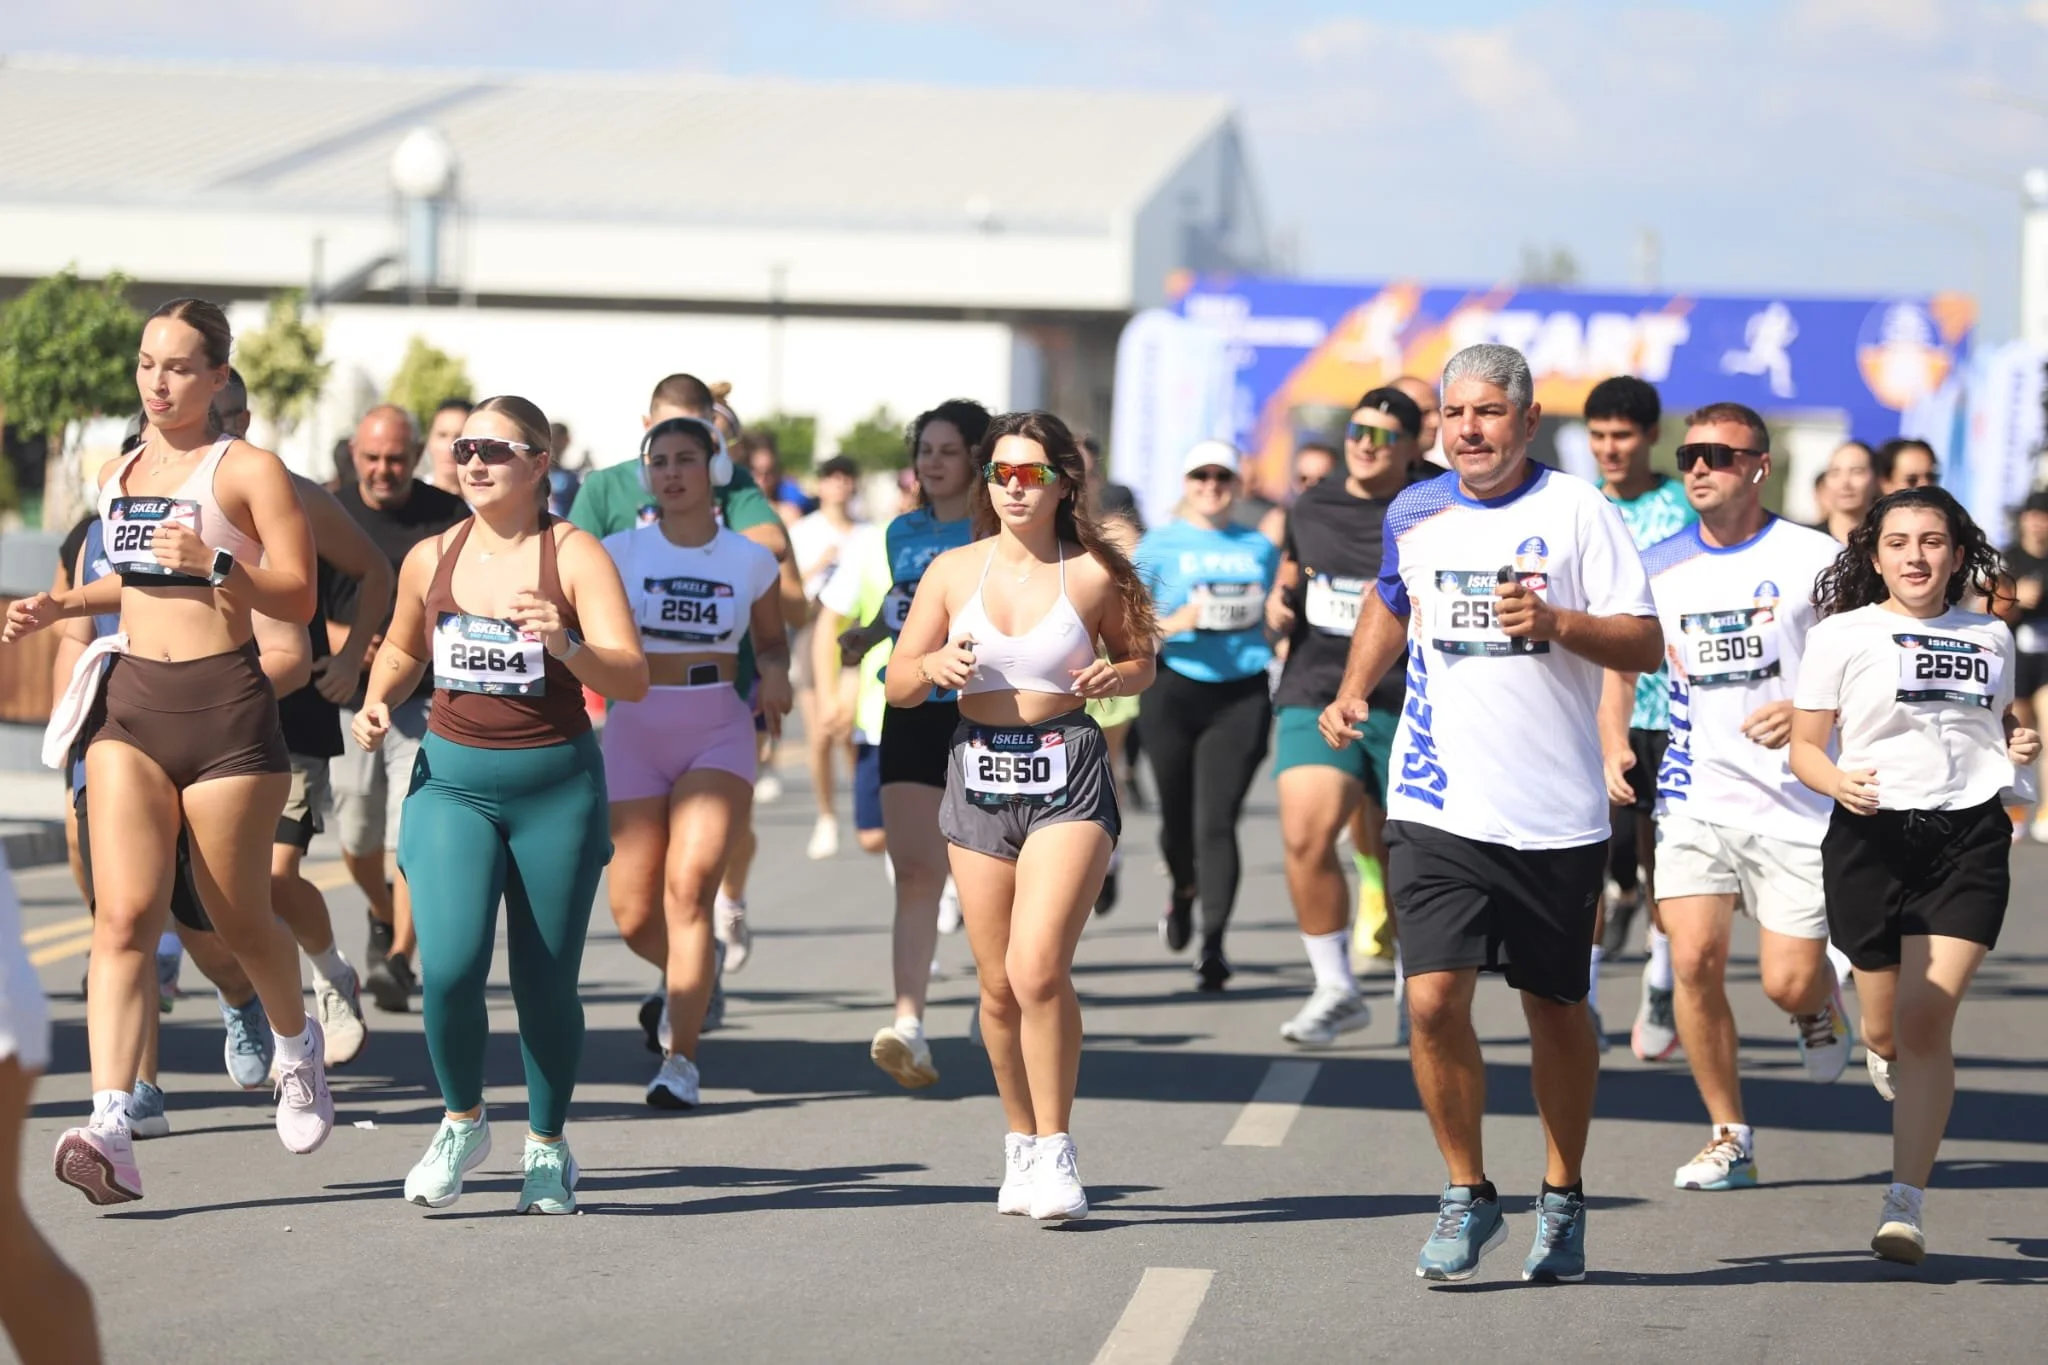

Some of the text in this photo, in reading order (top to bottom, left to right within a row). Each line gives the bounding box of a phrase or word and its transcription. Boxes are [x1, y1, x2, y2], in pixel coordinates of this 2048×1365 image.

[114, 524, 156, 552] 226
[1467, 574, 1497, 588] İSKE
[661, 599, 718, 625] 2514
[1451, 600, 1502, 629] 255
[450, 643, 527, 674] 2264
[1698, 635, 1764, 663] 2509
[1915, 653, 1989, 684] 2590
[991, 732, 1035, 745] İSKELE
[978, 755, 1051, 784] 2550
